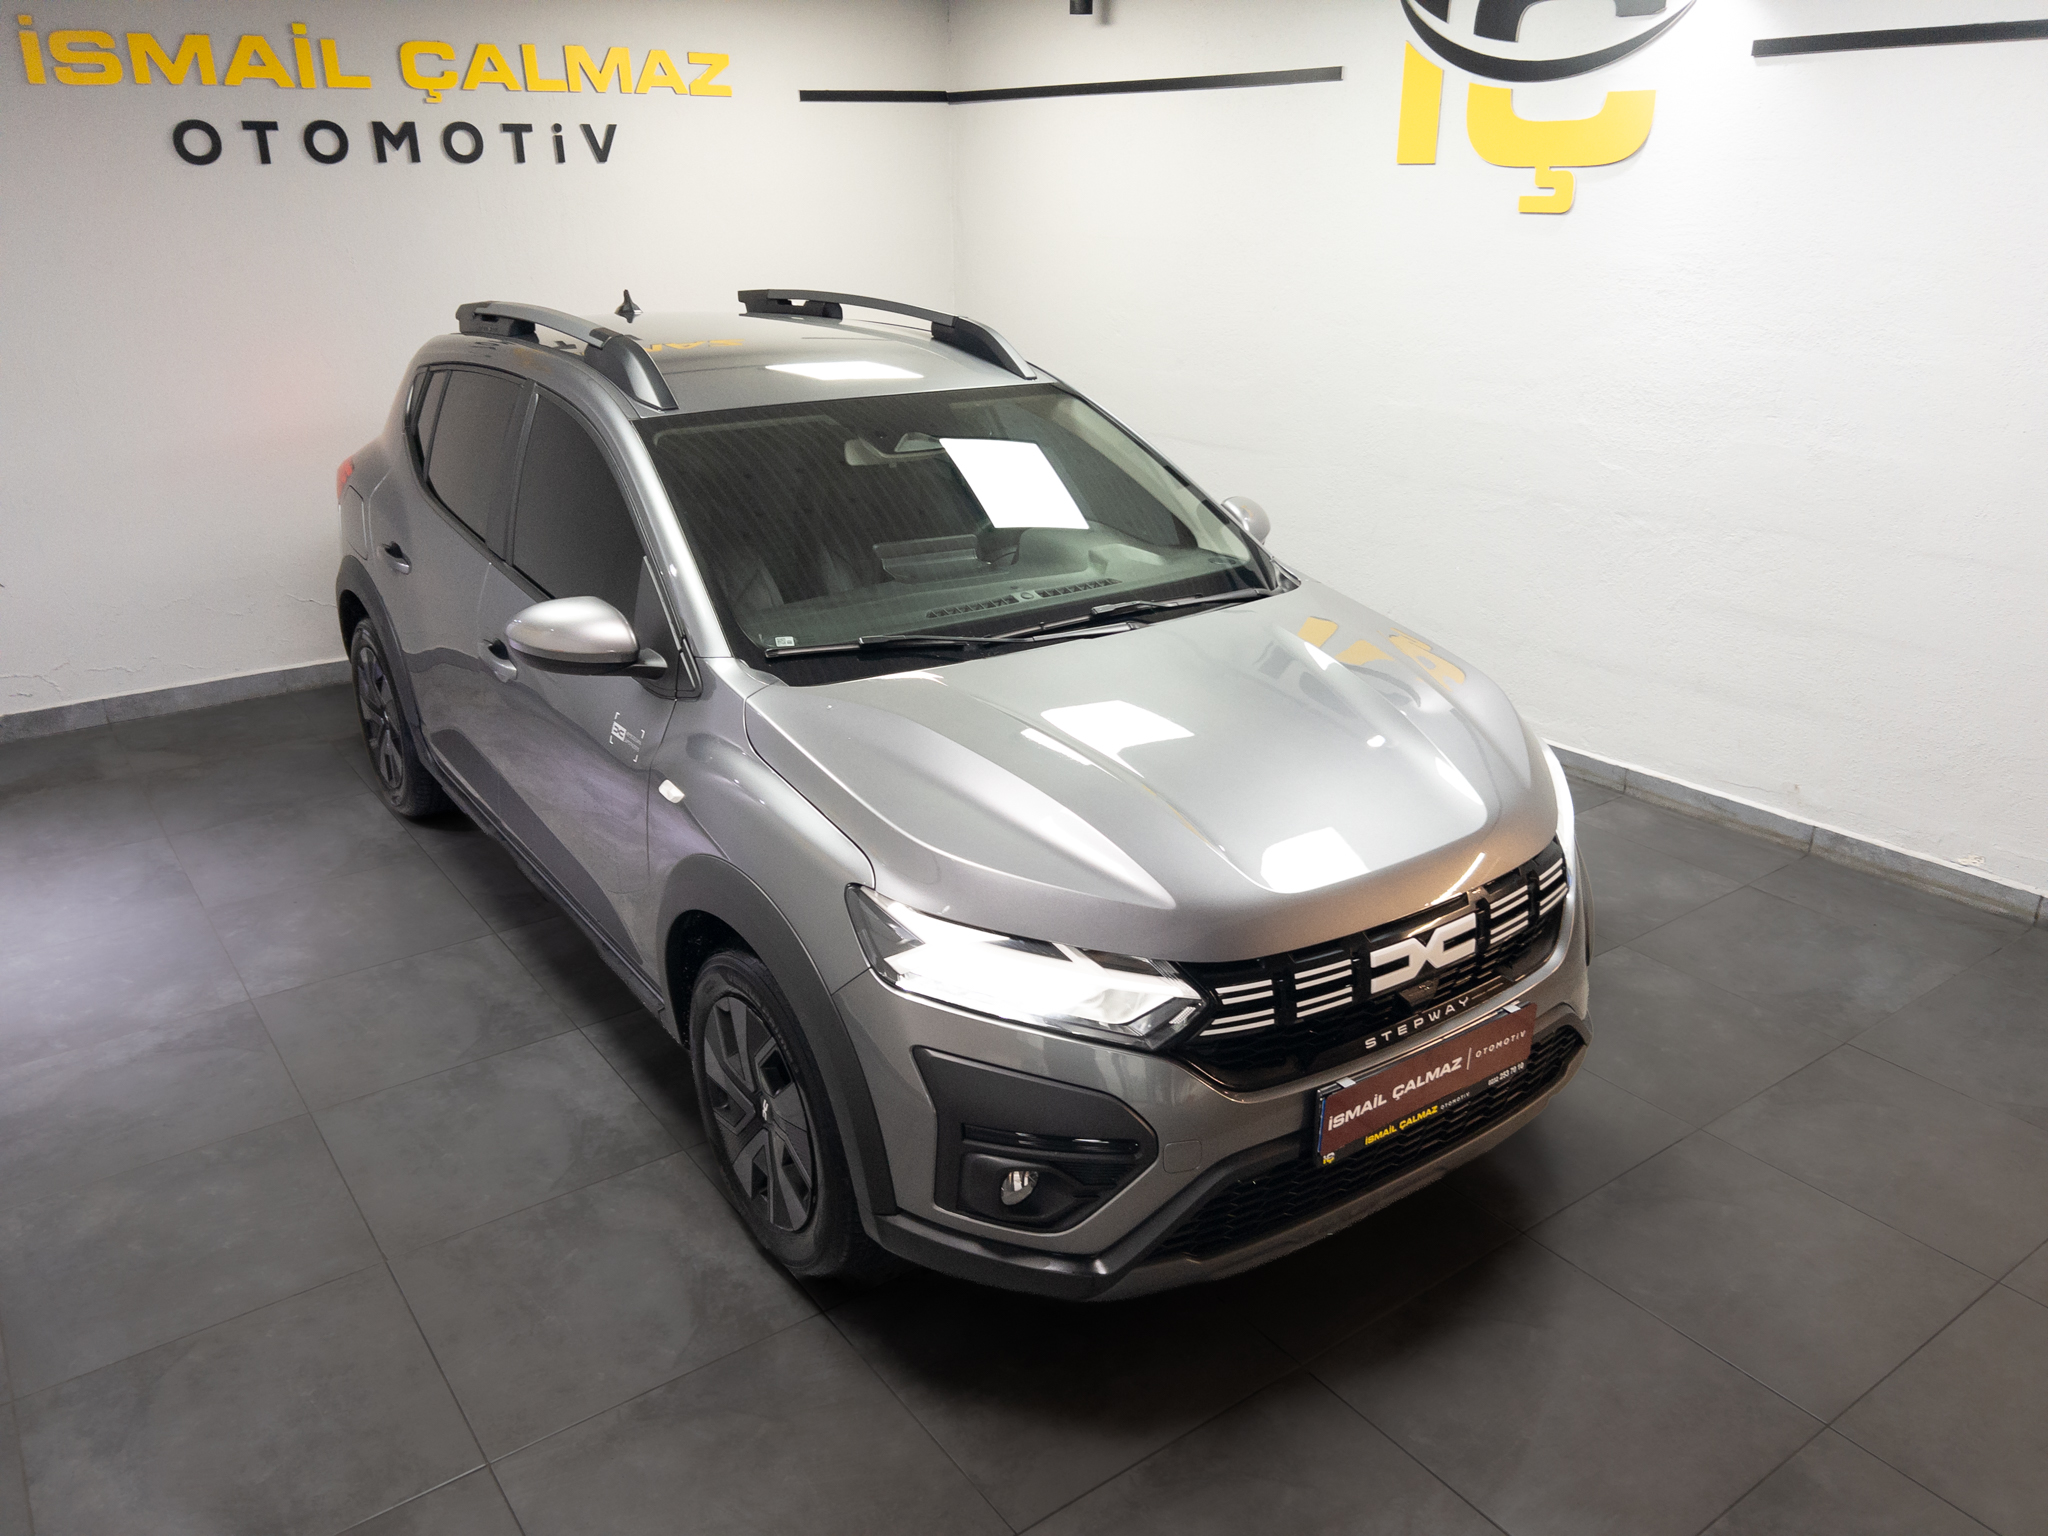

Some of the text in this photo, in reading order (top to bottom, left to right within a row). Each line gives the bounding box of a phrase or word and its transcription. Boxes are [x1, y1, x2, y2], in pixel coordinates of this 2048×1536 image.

[18, 14, 733, 104] İSMAİL ÇALMAZ
[1365, 996, 1470, 1050] STEPWAY
[1327, 1093, 1388, 1131] İSMAİL
[1392, 1056, 1463, 1100] ÇALMAZ
[1365, 1119, 1398, 1145] İSMAİL
[1399, 1105, 1438, 1130] ÇALMAZ
